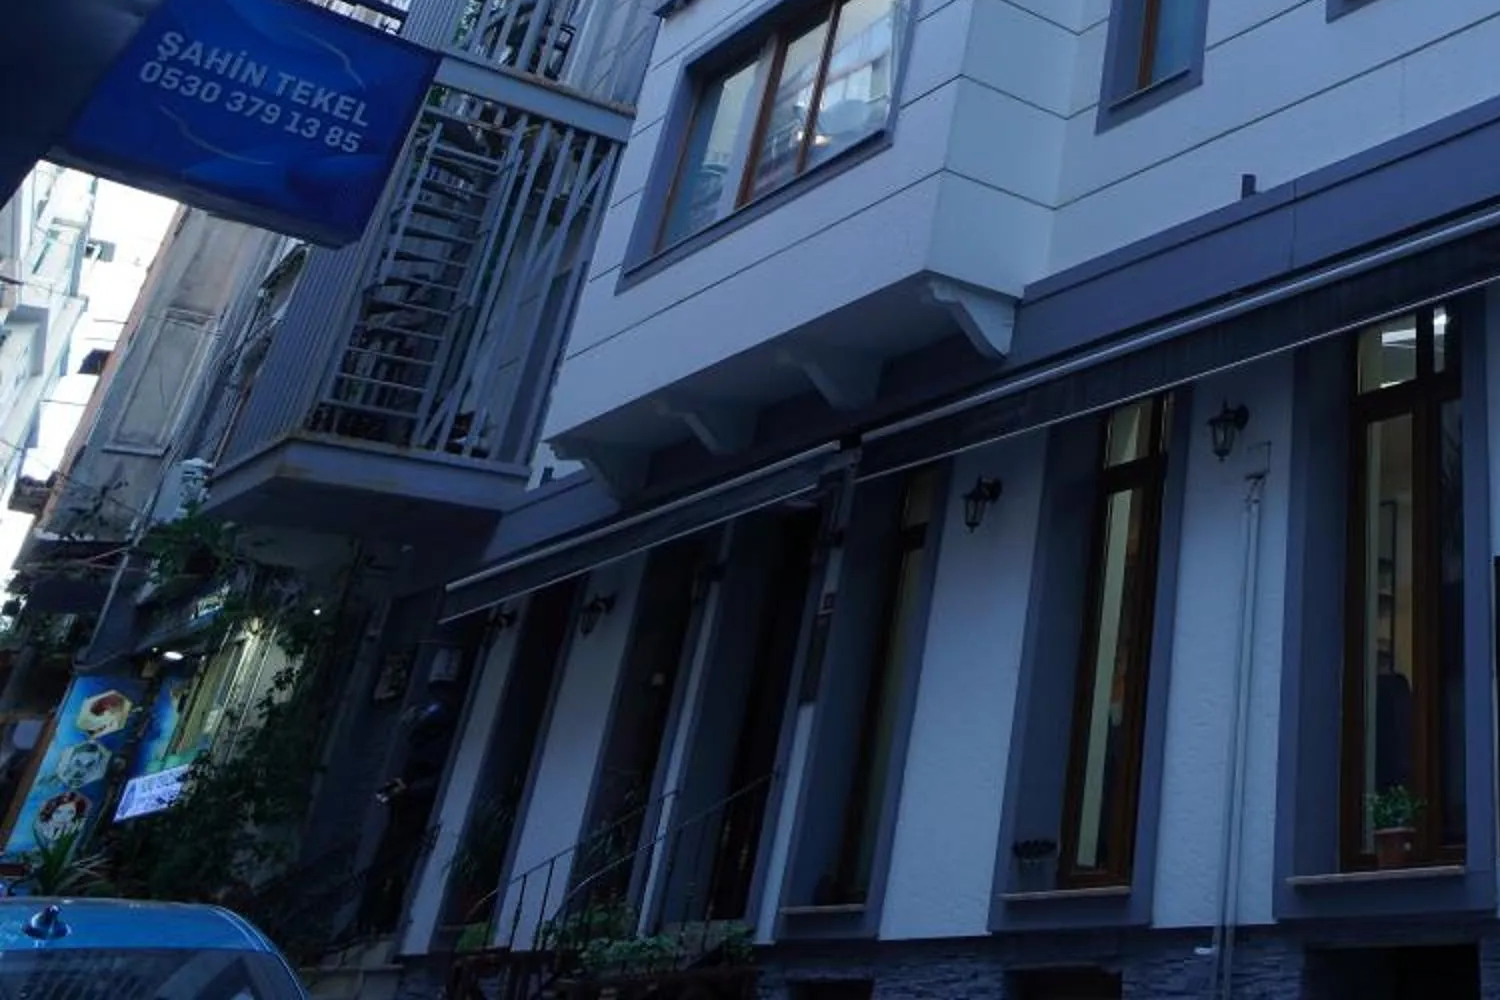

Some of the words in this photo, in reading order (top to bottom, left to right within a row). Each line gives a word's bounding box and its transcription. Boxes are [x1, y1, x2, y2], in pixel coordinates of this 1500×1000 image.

[140, 62, 221, 105] 0530
[226, 89, 282, 126] 379
[284, 110, 319, 140] 13
[325, 126, 361, 154] 85
[156, 31, 268, 89] ŞAHİN
[276, 72, 369, 127] TEKEL
